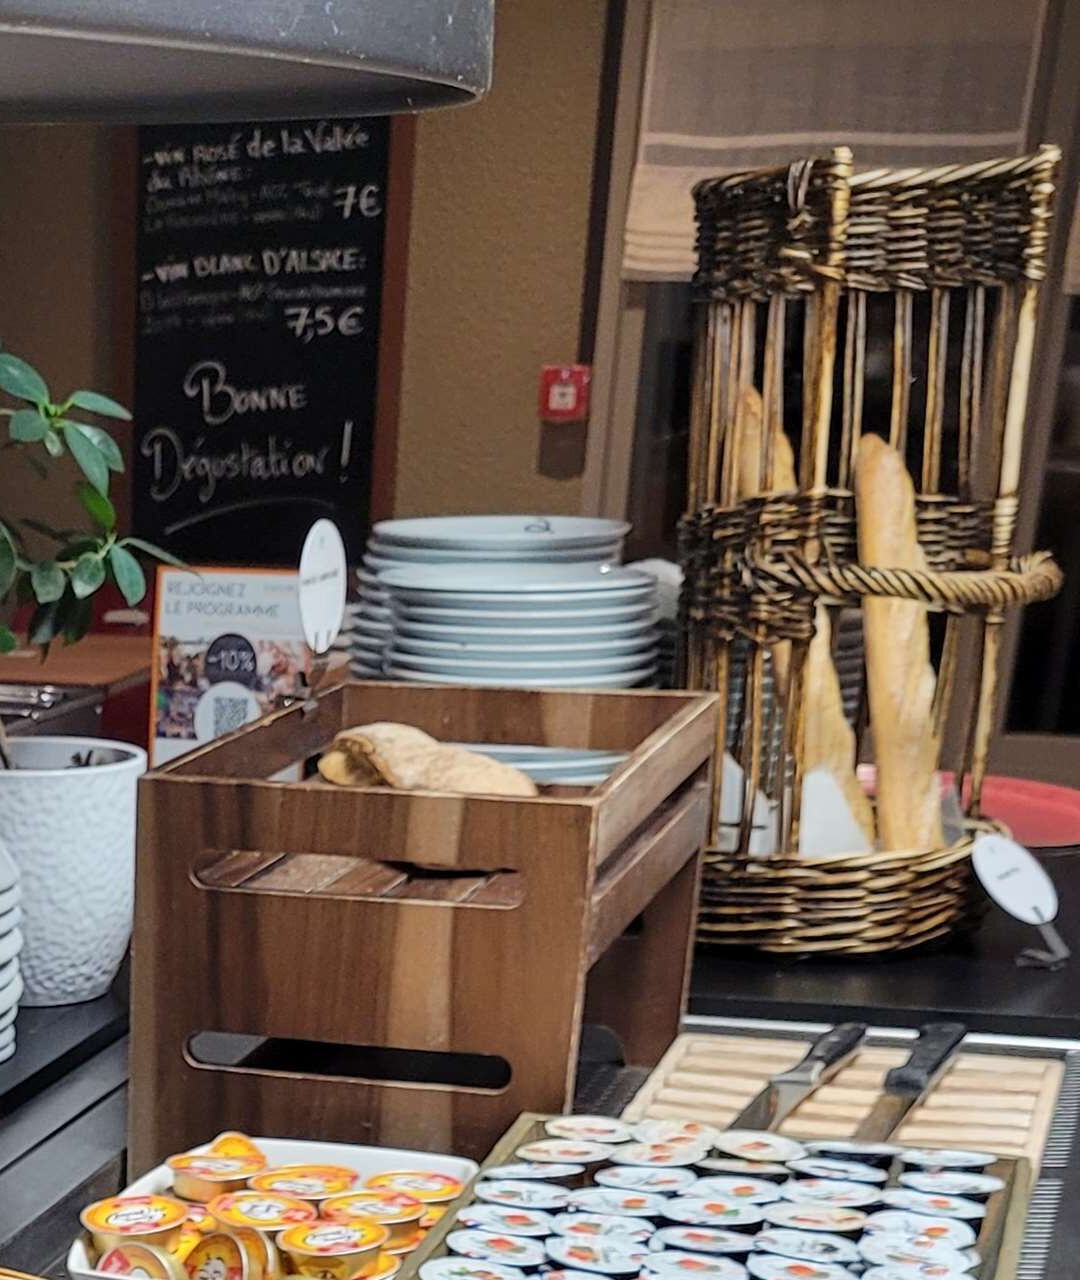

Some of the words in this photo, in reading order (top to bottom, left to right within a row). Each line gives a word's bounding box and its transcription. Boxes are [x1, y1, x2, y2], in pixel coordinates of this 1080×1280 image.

[246, 128, 276, 159] de
[280, 128, 306, 155] la
[333, 184, 383, 220] 7€
[283, 304, 366, 344] 7,5€
